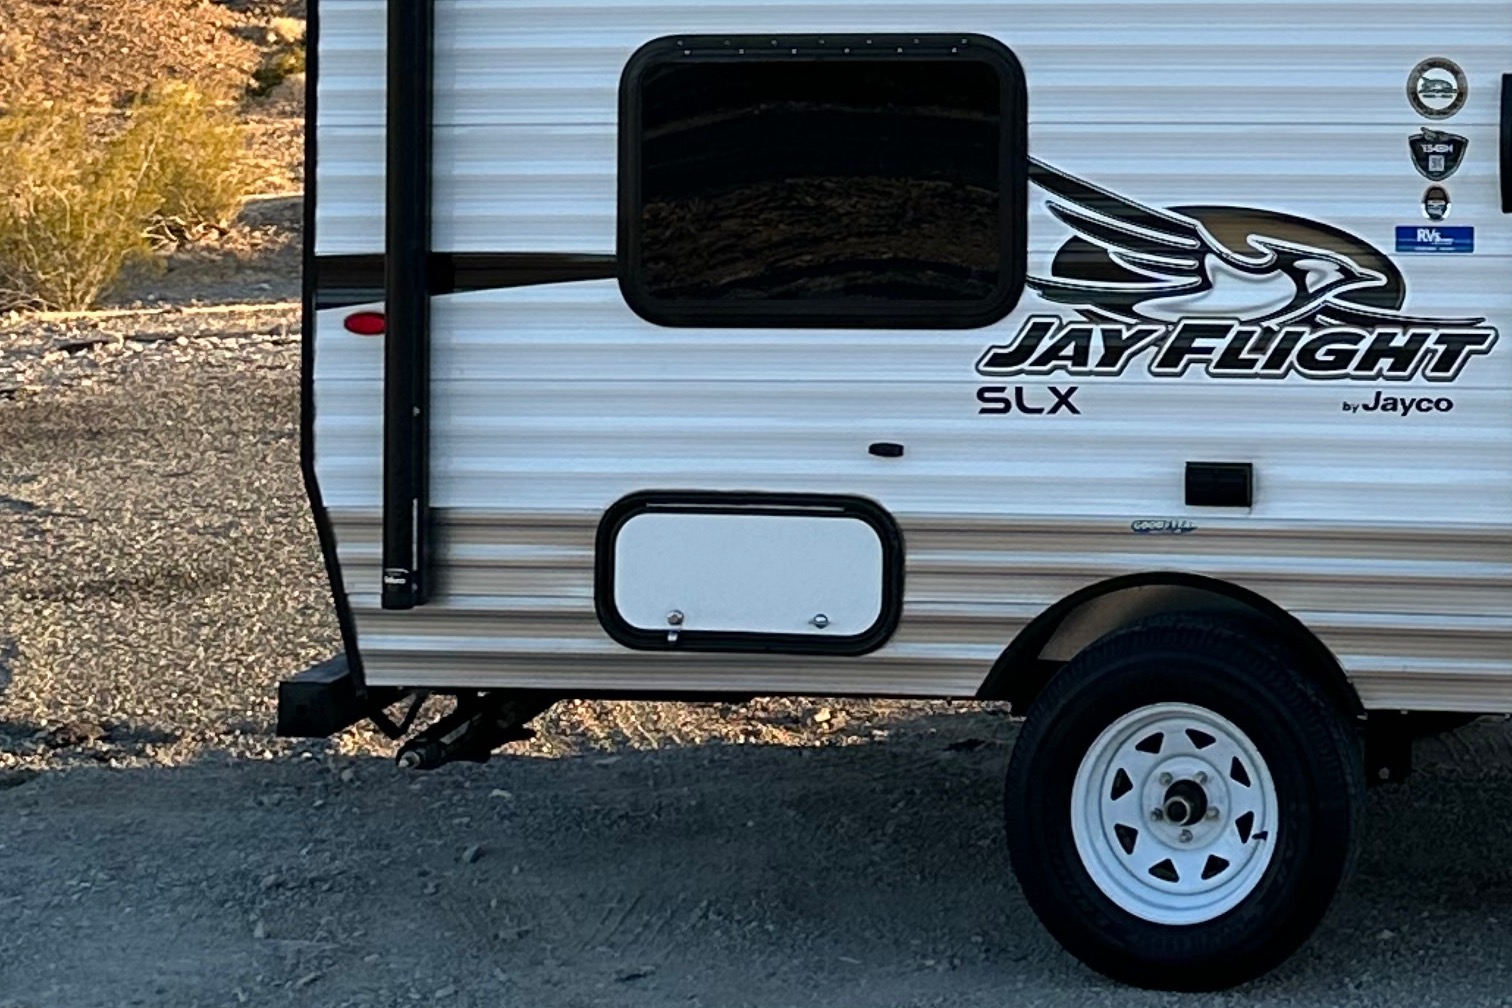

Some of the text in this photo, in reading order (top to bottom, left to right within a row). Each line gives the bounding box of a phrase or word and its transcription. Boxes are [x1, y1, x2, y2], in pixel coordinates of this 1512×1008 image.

[975, 314, 1499, 382] JAY FLIGHT
[976, 386, 1081, 415] SLX
[1342, 390, 1454, 416] by Jayco
